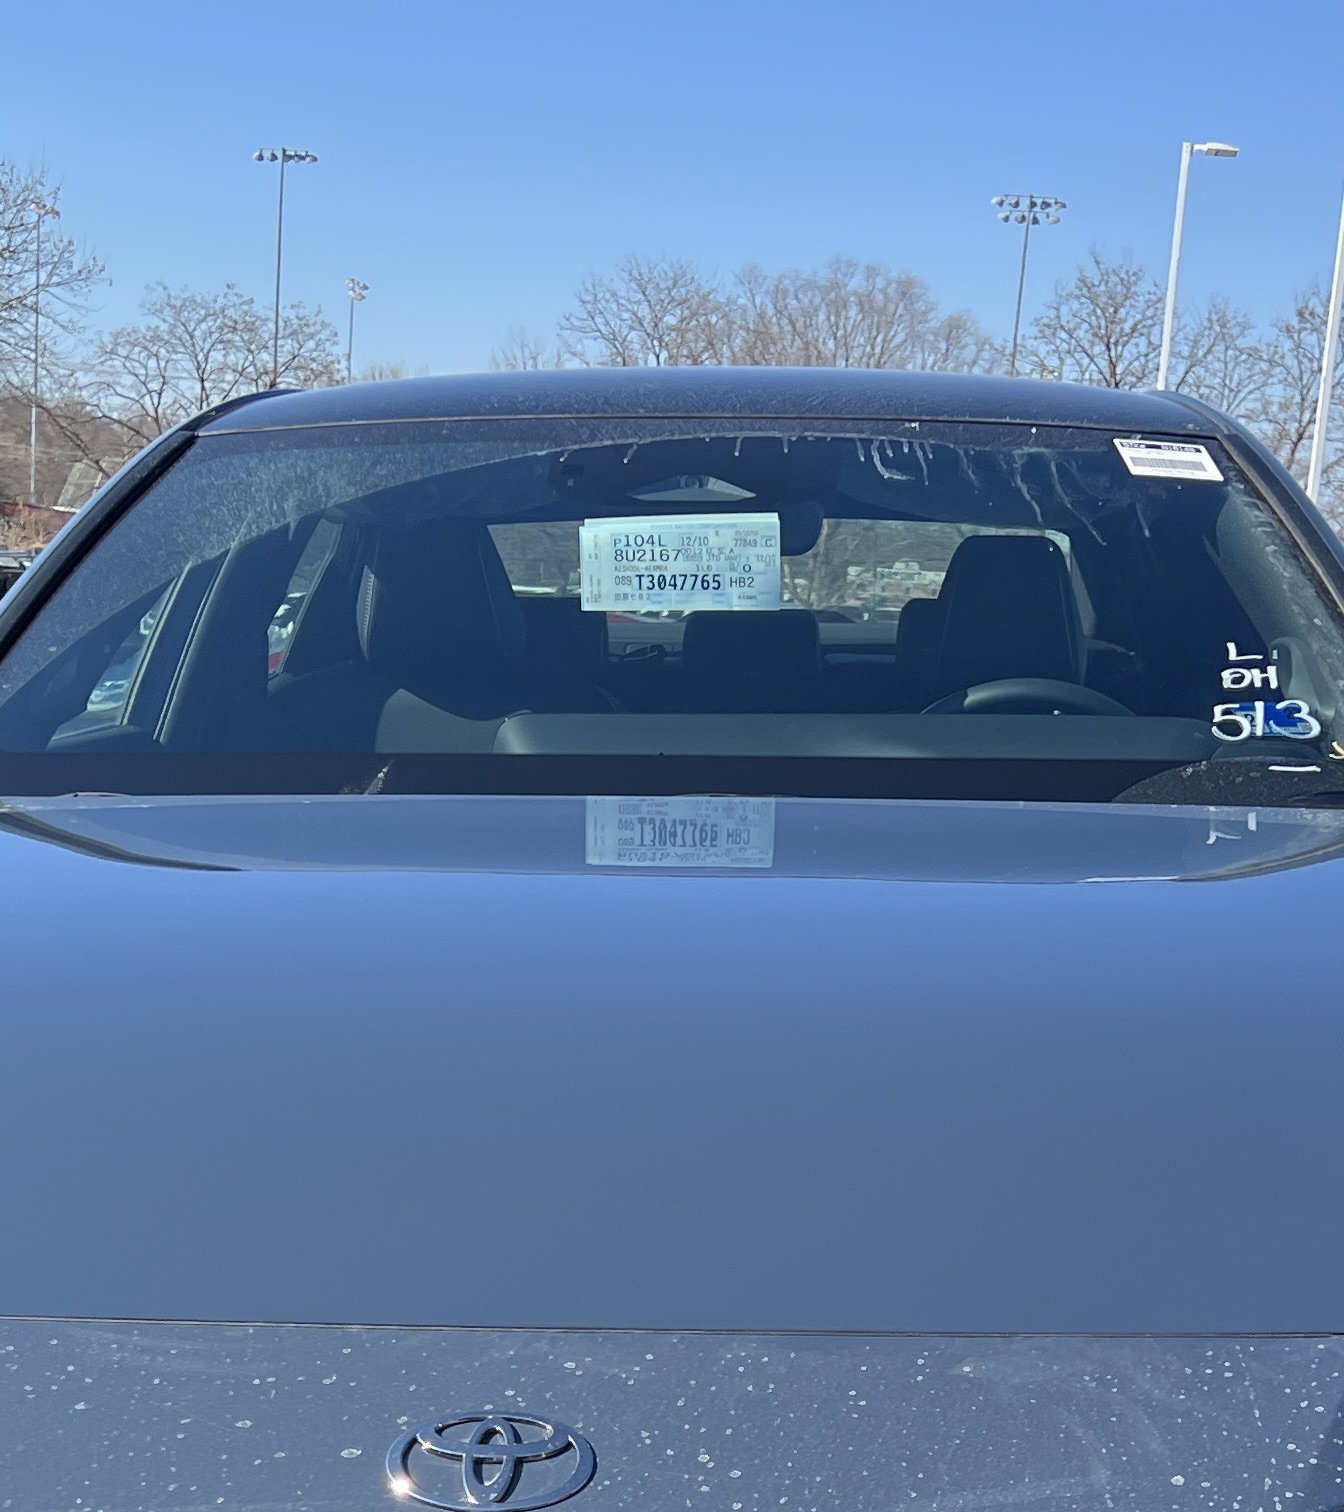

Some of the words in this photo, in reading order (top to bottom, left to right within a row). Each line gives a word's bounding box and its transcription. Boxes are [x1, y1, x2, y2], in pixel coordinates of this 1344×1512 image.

[680, 535, 709, 547] 12/10
[613, 548, 681, 562] 8U2167
[634, 573, 722, 591] T3047765
[729, 576, 755, 588] HB2
[1211, 699, 1322, 741] 513
